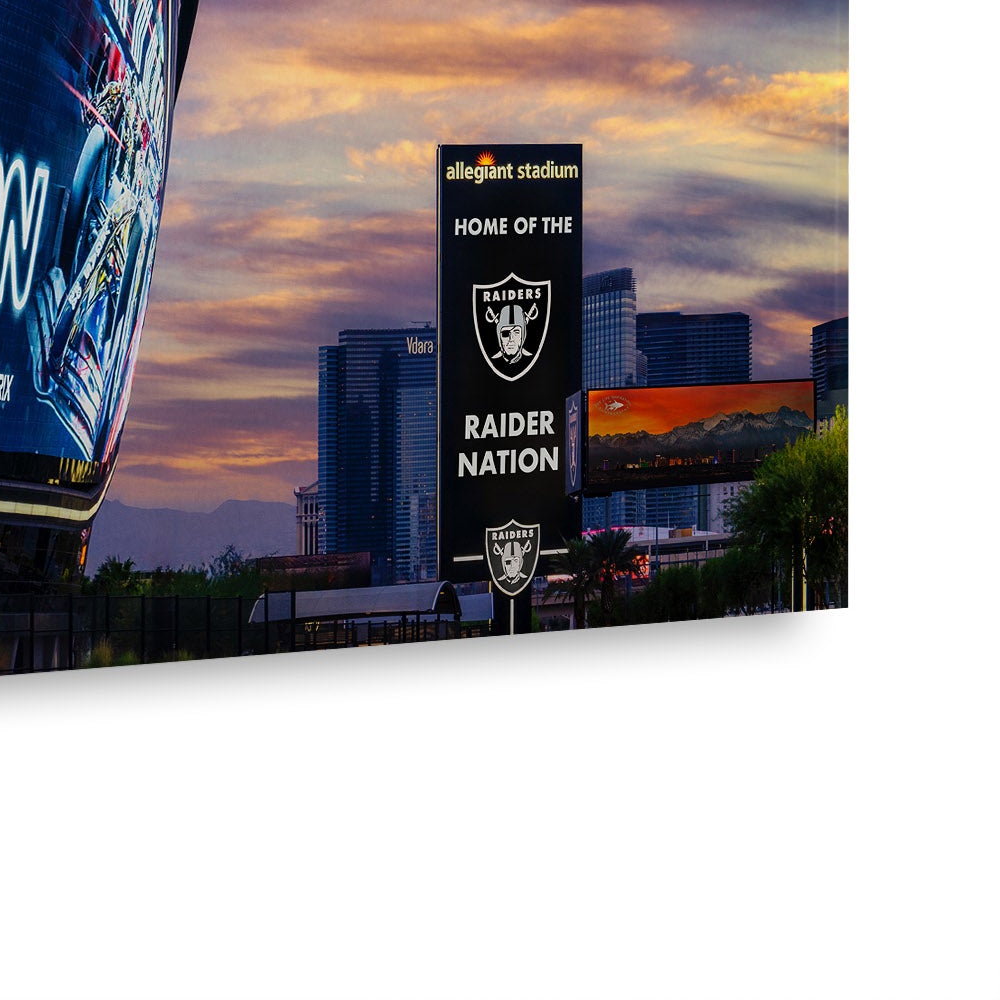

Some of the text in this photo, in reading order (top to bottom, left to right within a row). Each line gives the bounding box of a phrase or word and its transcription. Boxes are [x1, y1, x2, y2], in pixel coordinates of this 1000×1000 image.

[445, 160, 579, 184] allegiant stadium
[454, 216, 573, 236] HOME OF THE
[483, 287, 542, 302] RAIDERS
[406, 336, 434, 354] Vdara
[464, 410, 556, 440] RAIDER
[458, 446, 559, 477] NATION
[491, 529, 534, 541] RAIDERS
